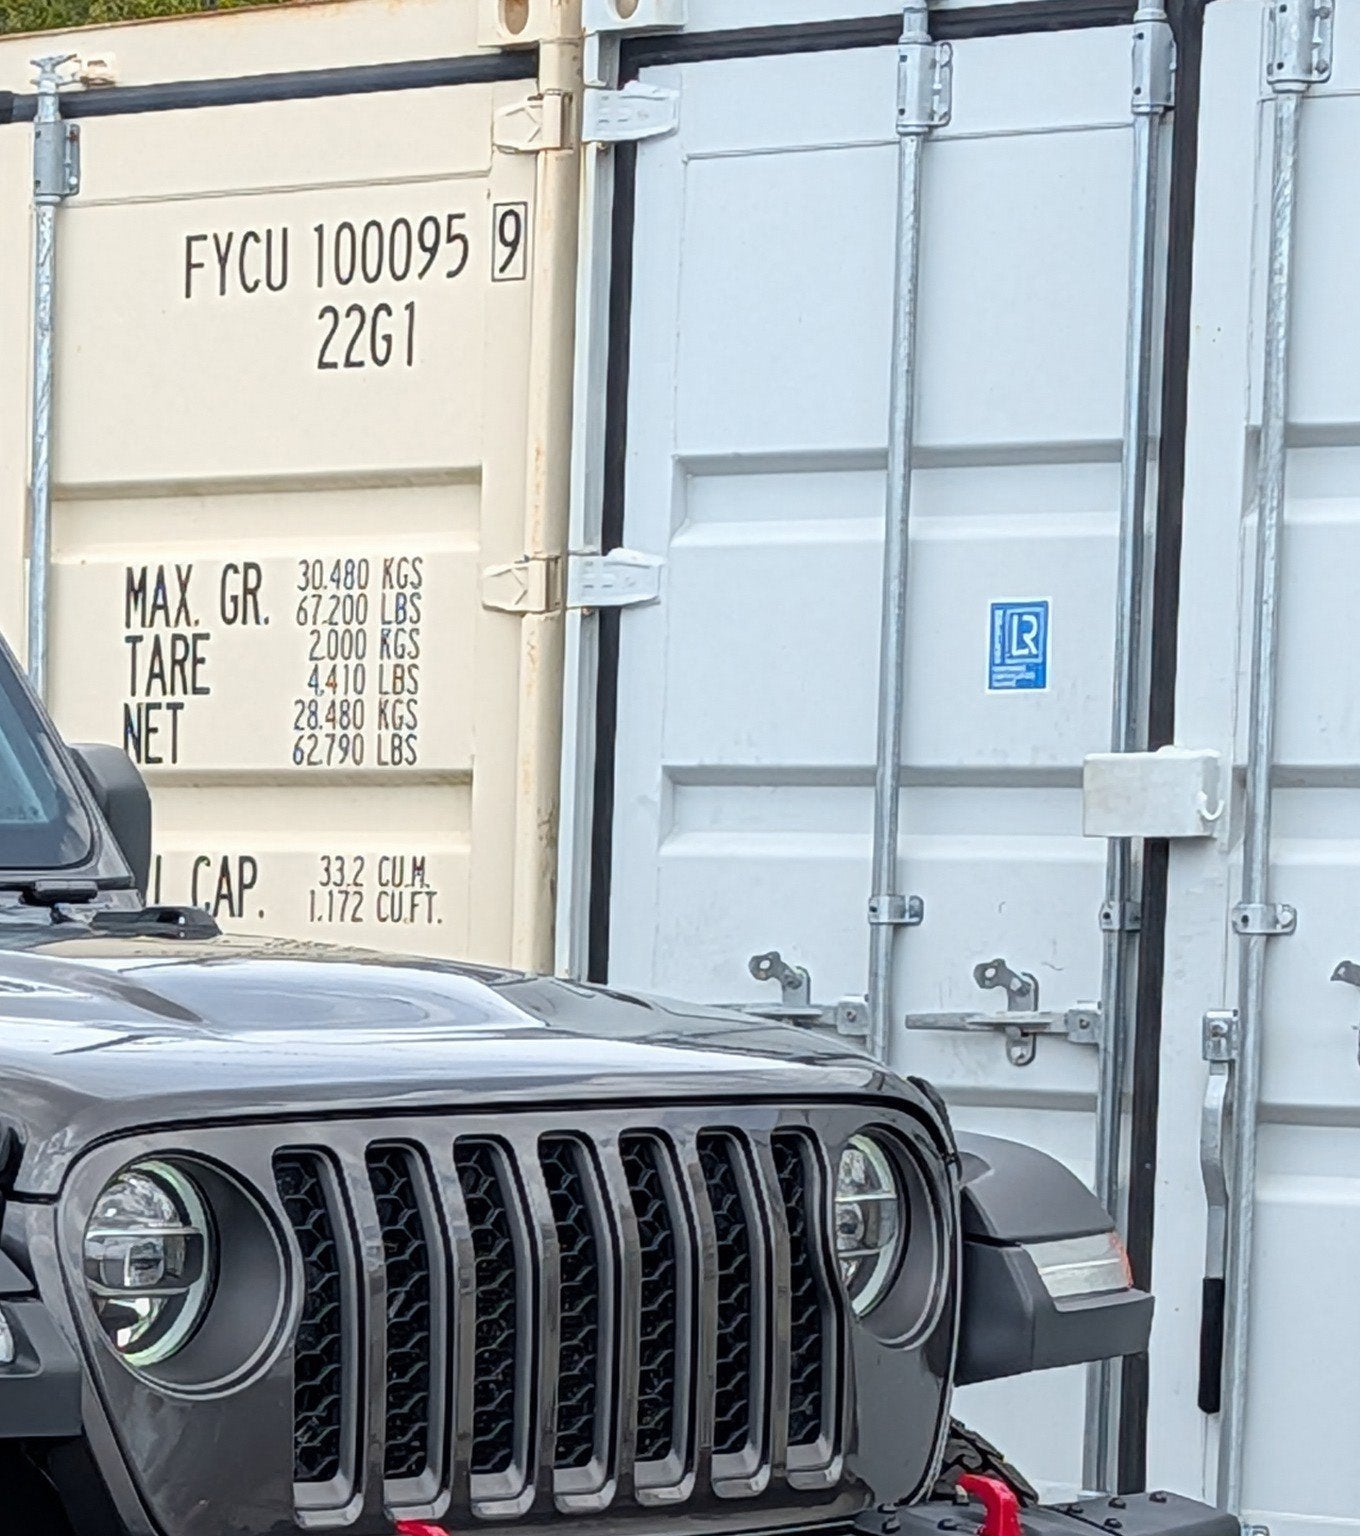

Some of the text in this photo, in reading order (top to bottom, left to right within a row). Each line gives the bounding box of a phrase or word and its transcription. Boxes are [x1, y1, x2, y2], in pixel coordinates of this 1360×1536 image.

[184, 208, 522, 299] FYCU 100095 9
[317, 301, 415, 370] 22G1
[124, 561, 270, 629] MAX. GR.
[296, 556, 423, 591] 30.480 KGS
[380, 591, 422, 626] LBS
[124, 632, 211, 697] TARE
[379, 627, 421, 661] KGS
[378, 663, 419, 696] LBS
[123, 701, 185, 765] NET
[292, 698, 419, 731] 28.480 KGS
[377, 732, 418, 767] LBS
[191, 854, 265, 918] CAP.
